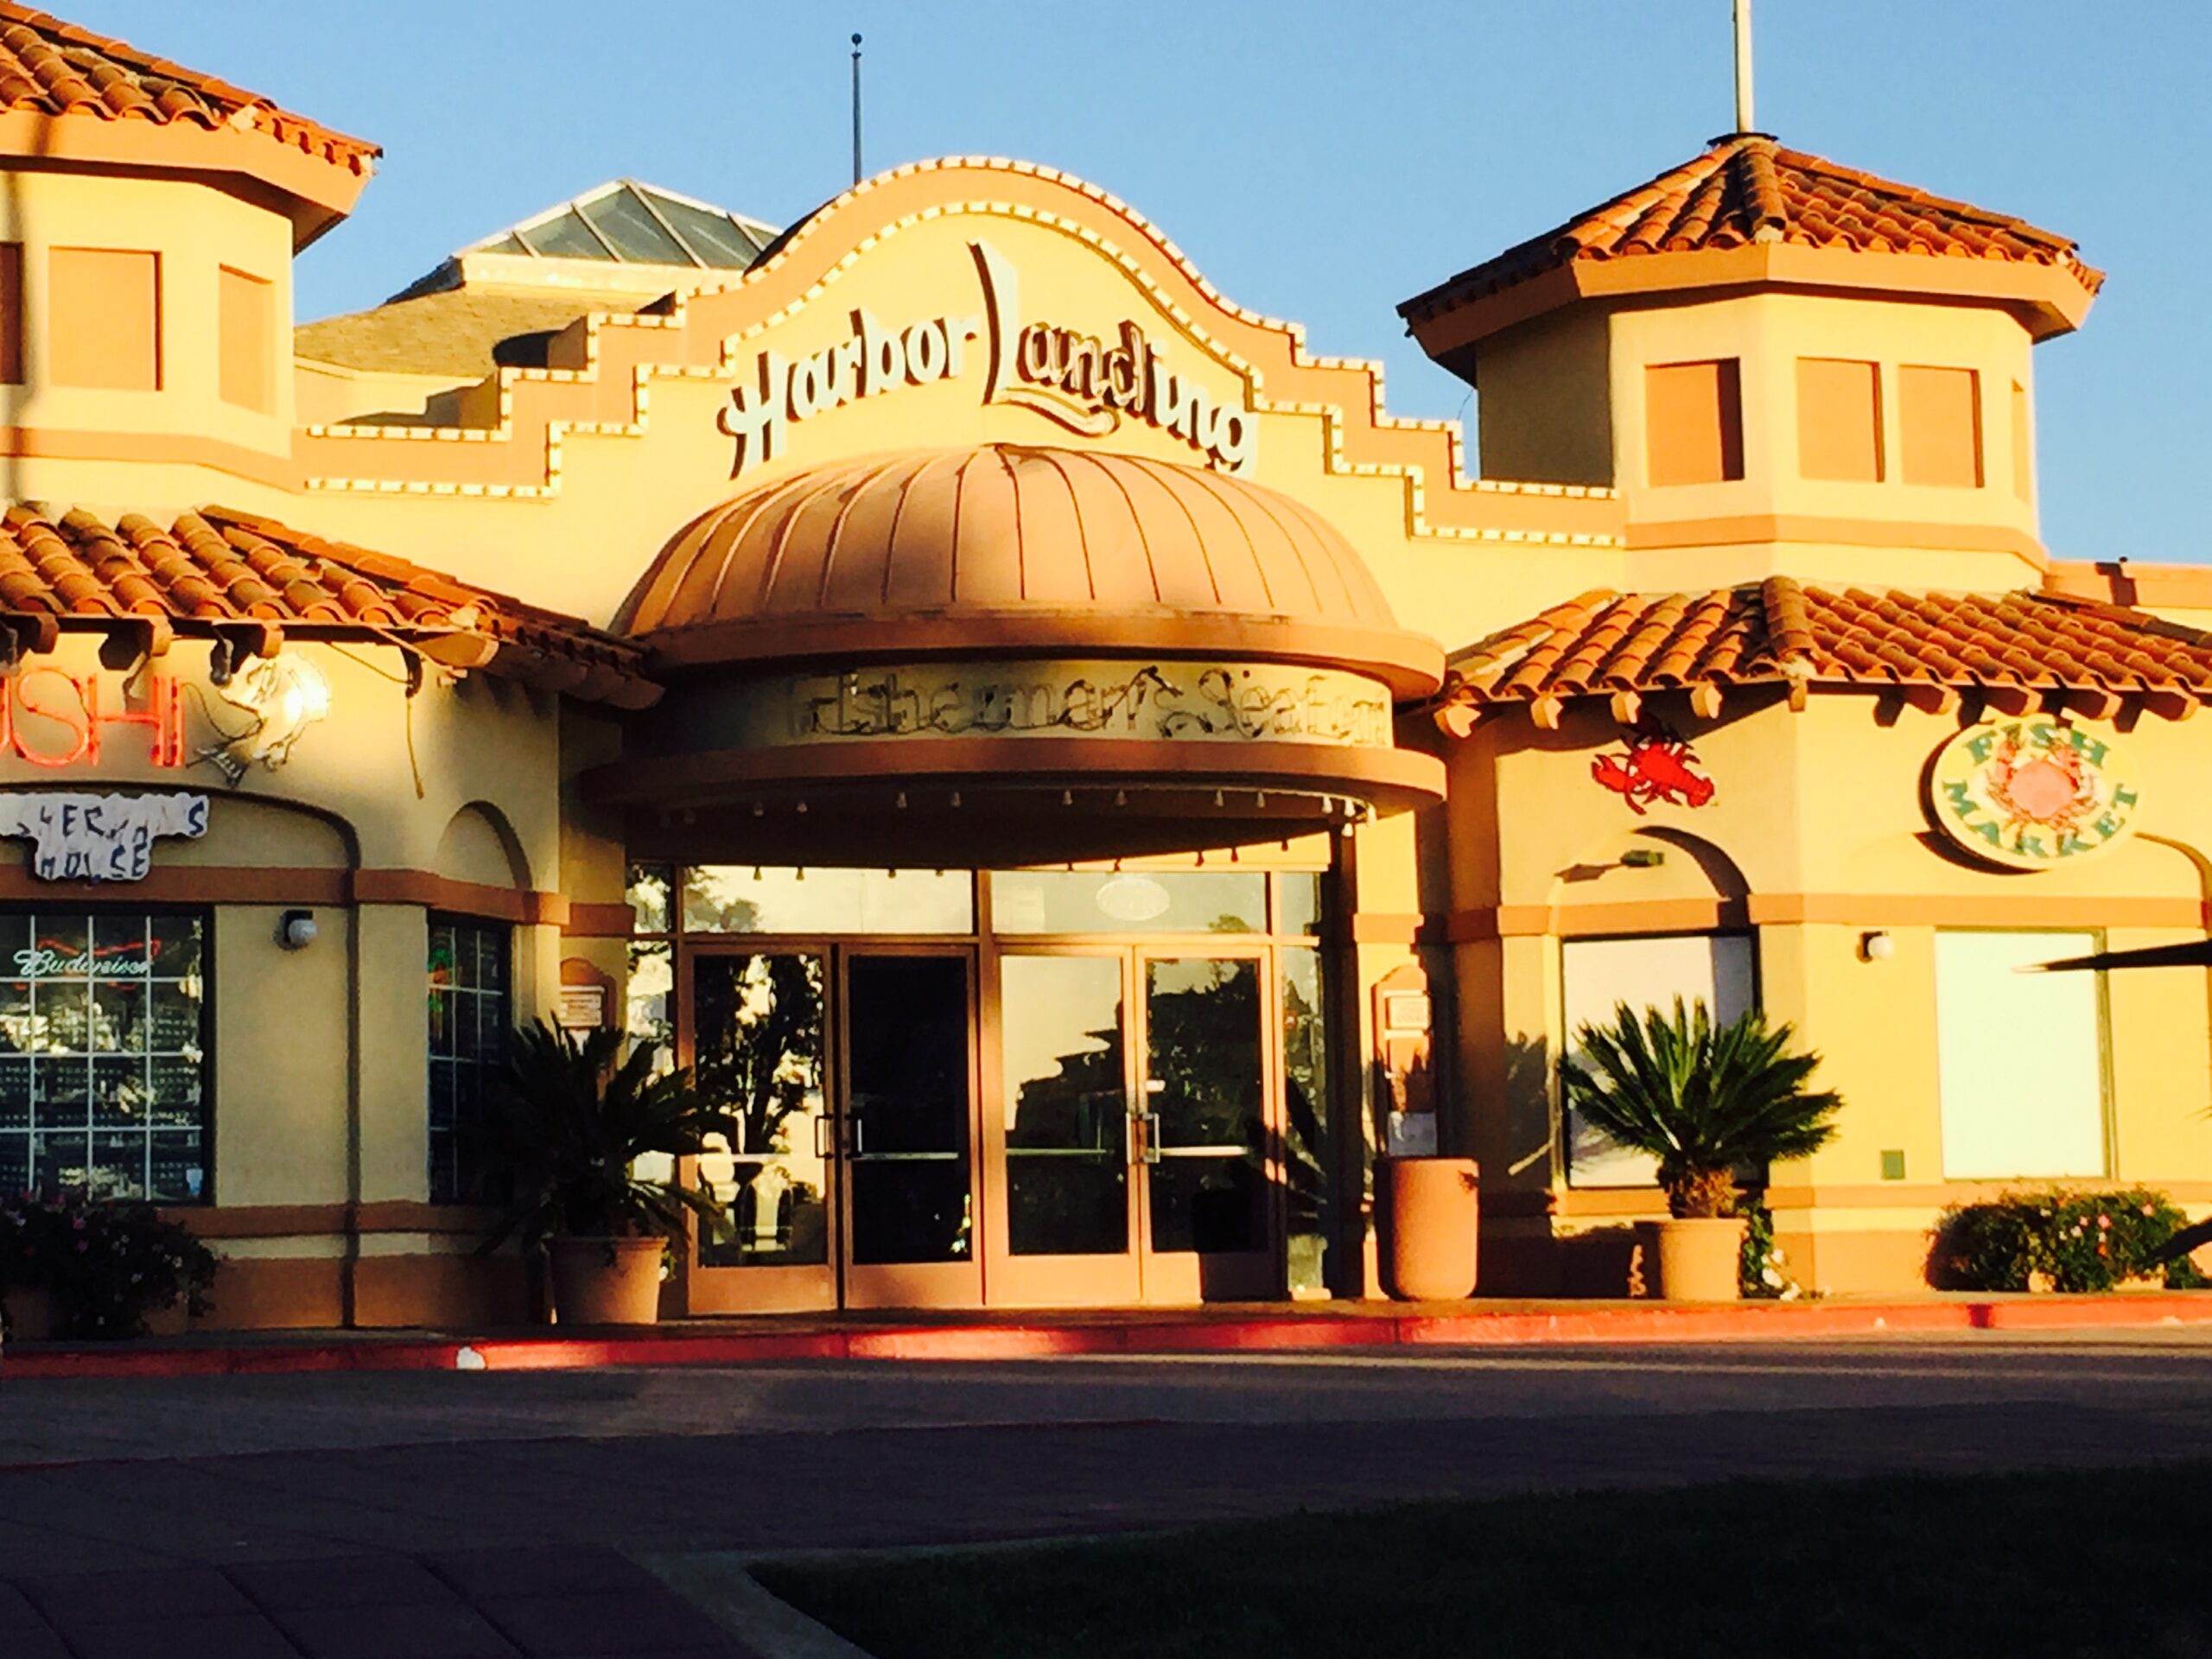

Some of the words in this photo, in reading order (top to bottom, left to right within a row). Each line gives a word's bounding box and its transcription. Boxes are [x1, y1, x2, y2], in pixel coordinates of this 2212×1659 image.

[718, 308, 979, 480] Harbor
[967, 239, 1253, 478] Landing
[0, 666, 186, 766] SHI
[1963, 722, 2110, 770] FISH
[1942, 781, 2138, 859] MARKET
[13, 949, 152, 976] Budweiser
